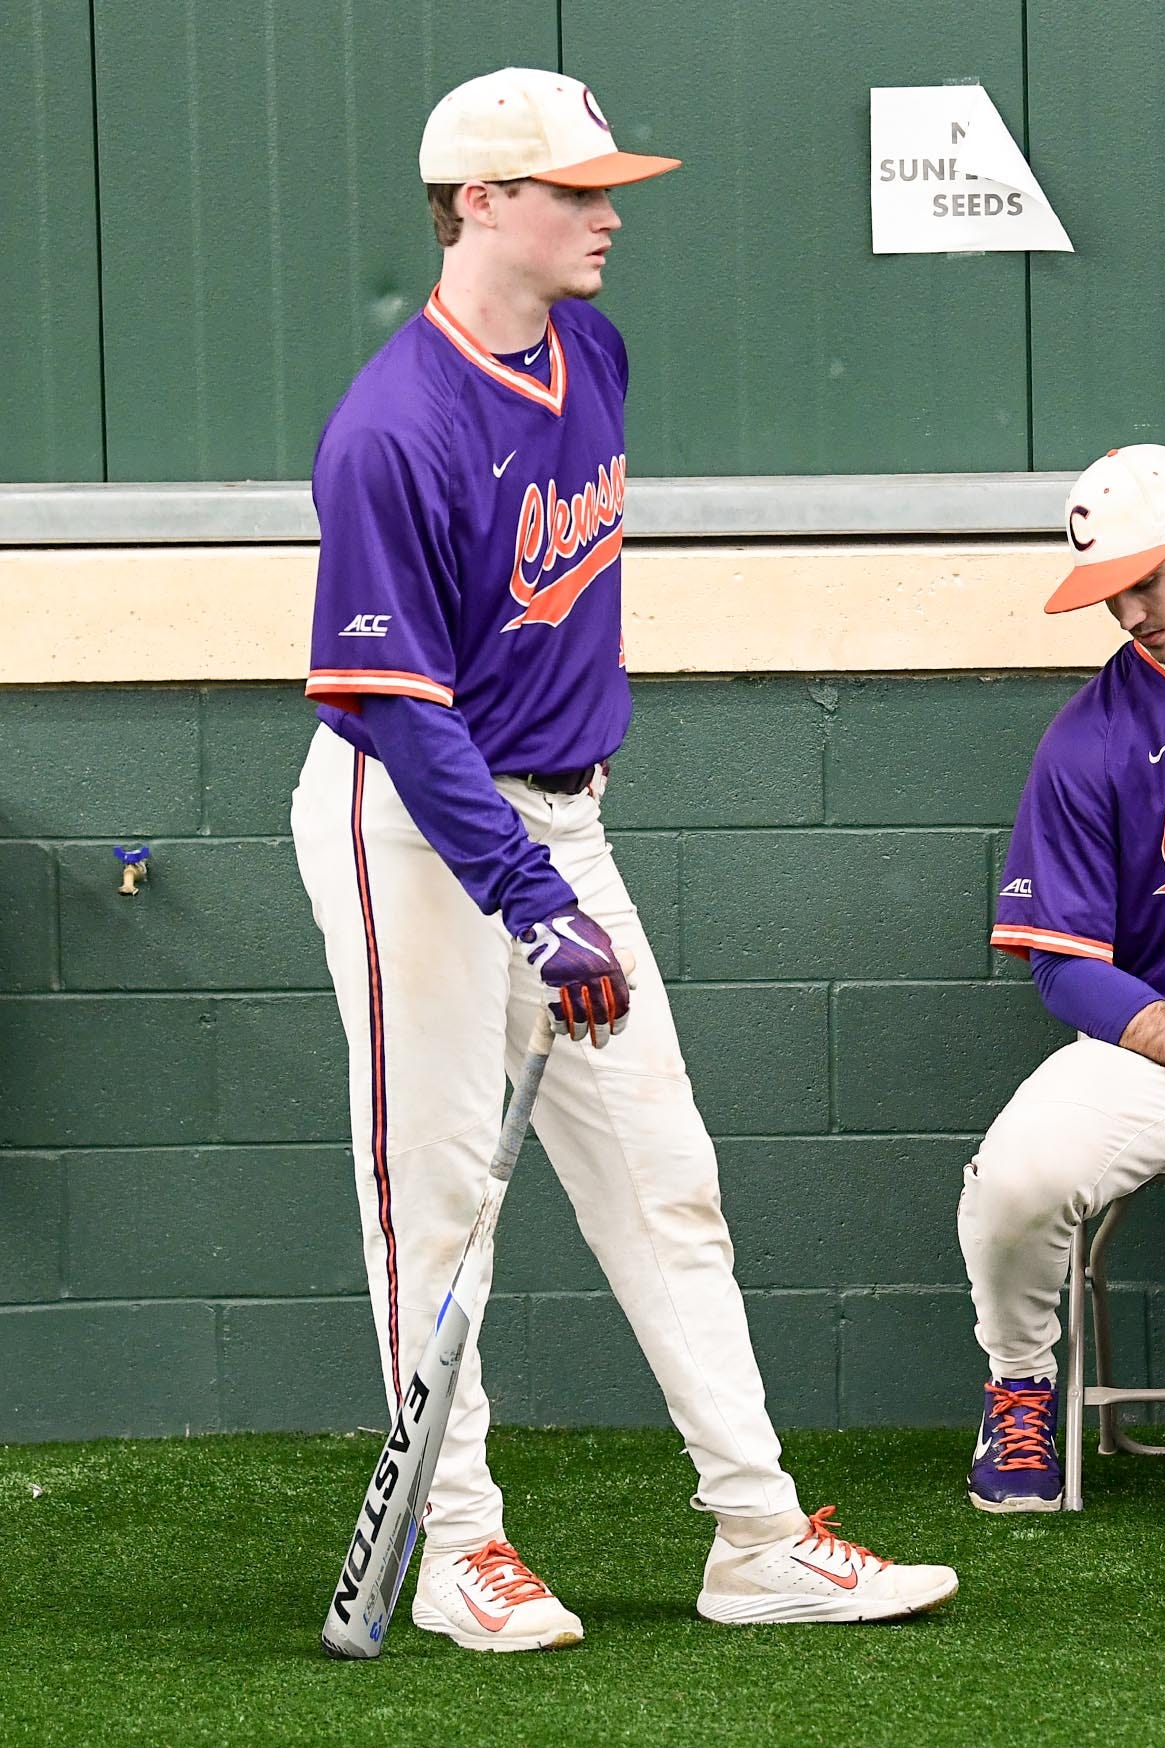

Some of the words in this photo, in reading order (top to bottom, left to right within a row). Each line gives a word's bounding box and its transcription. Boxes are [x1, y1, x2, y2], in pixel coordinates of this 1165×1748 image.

[951, 121, 970, 144] N
[933, 192, 1023, 218] SEEDS
[510, 453, 626, 607] Clemso
[1069, 505, 1097, 552] C
[343, 614, 392, 632] ACC
[334, 1370, 430, 1625] EASTON
